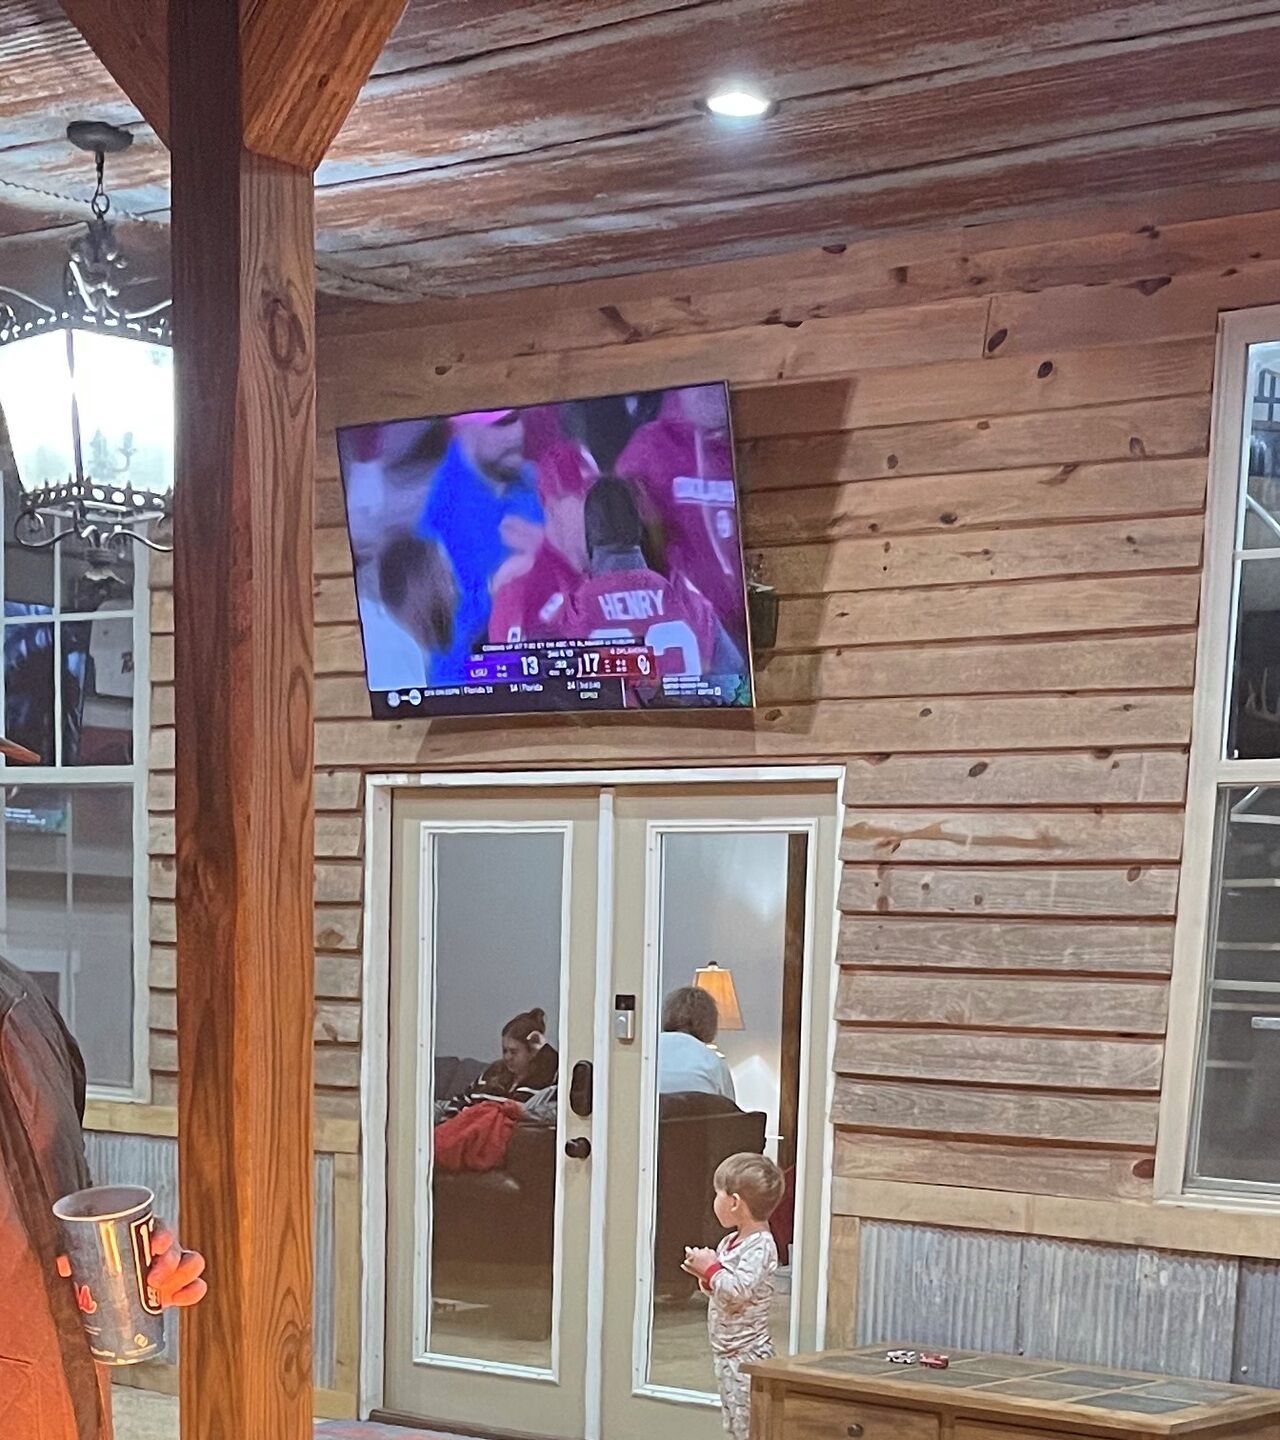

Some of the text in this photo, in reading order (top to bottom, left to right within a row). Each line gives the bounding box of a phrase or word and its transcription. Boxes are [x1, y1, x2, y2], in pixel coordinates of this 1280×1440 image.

[597, 589, 664, 621] HENRY
[520, 656, 539, 676] 13
[583, 653, 600, 673] 17
